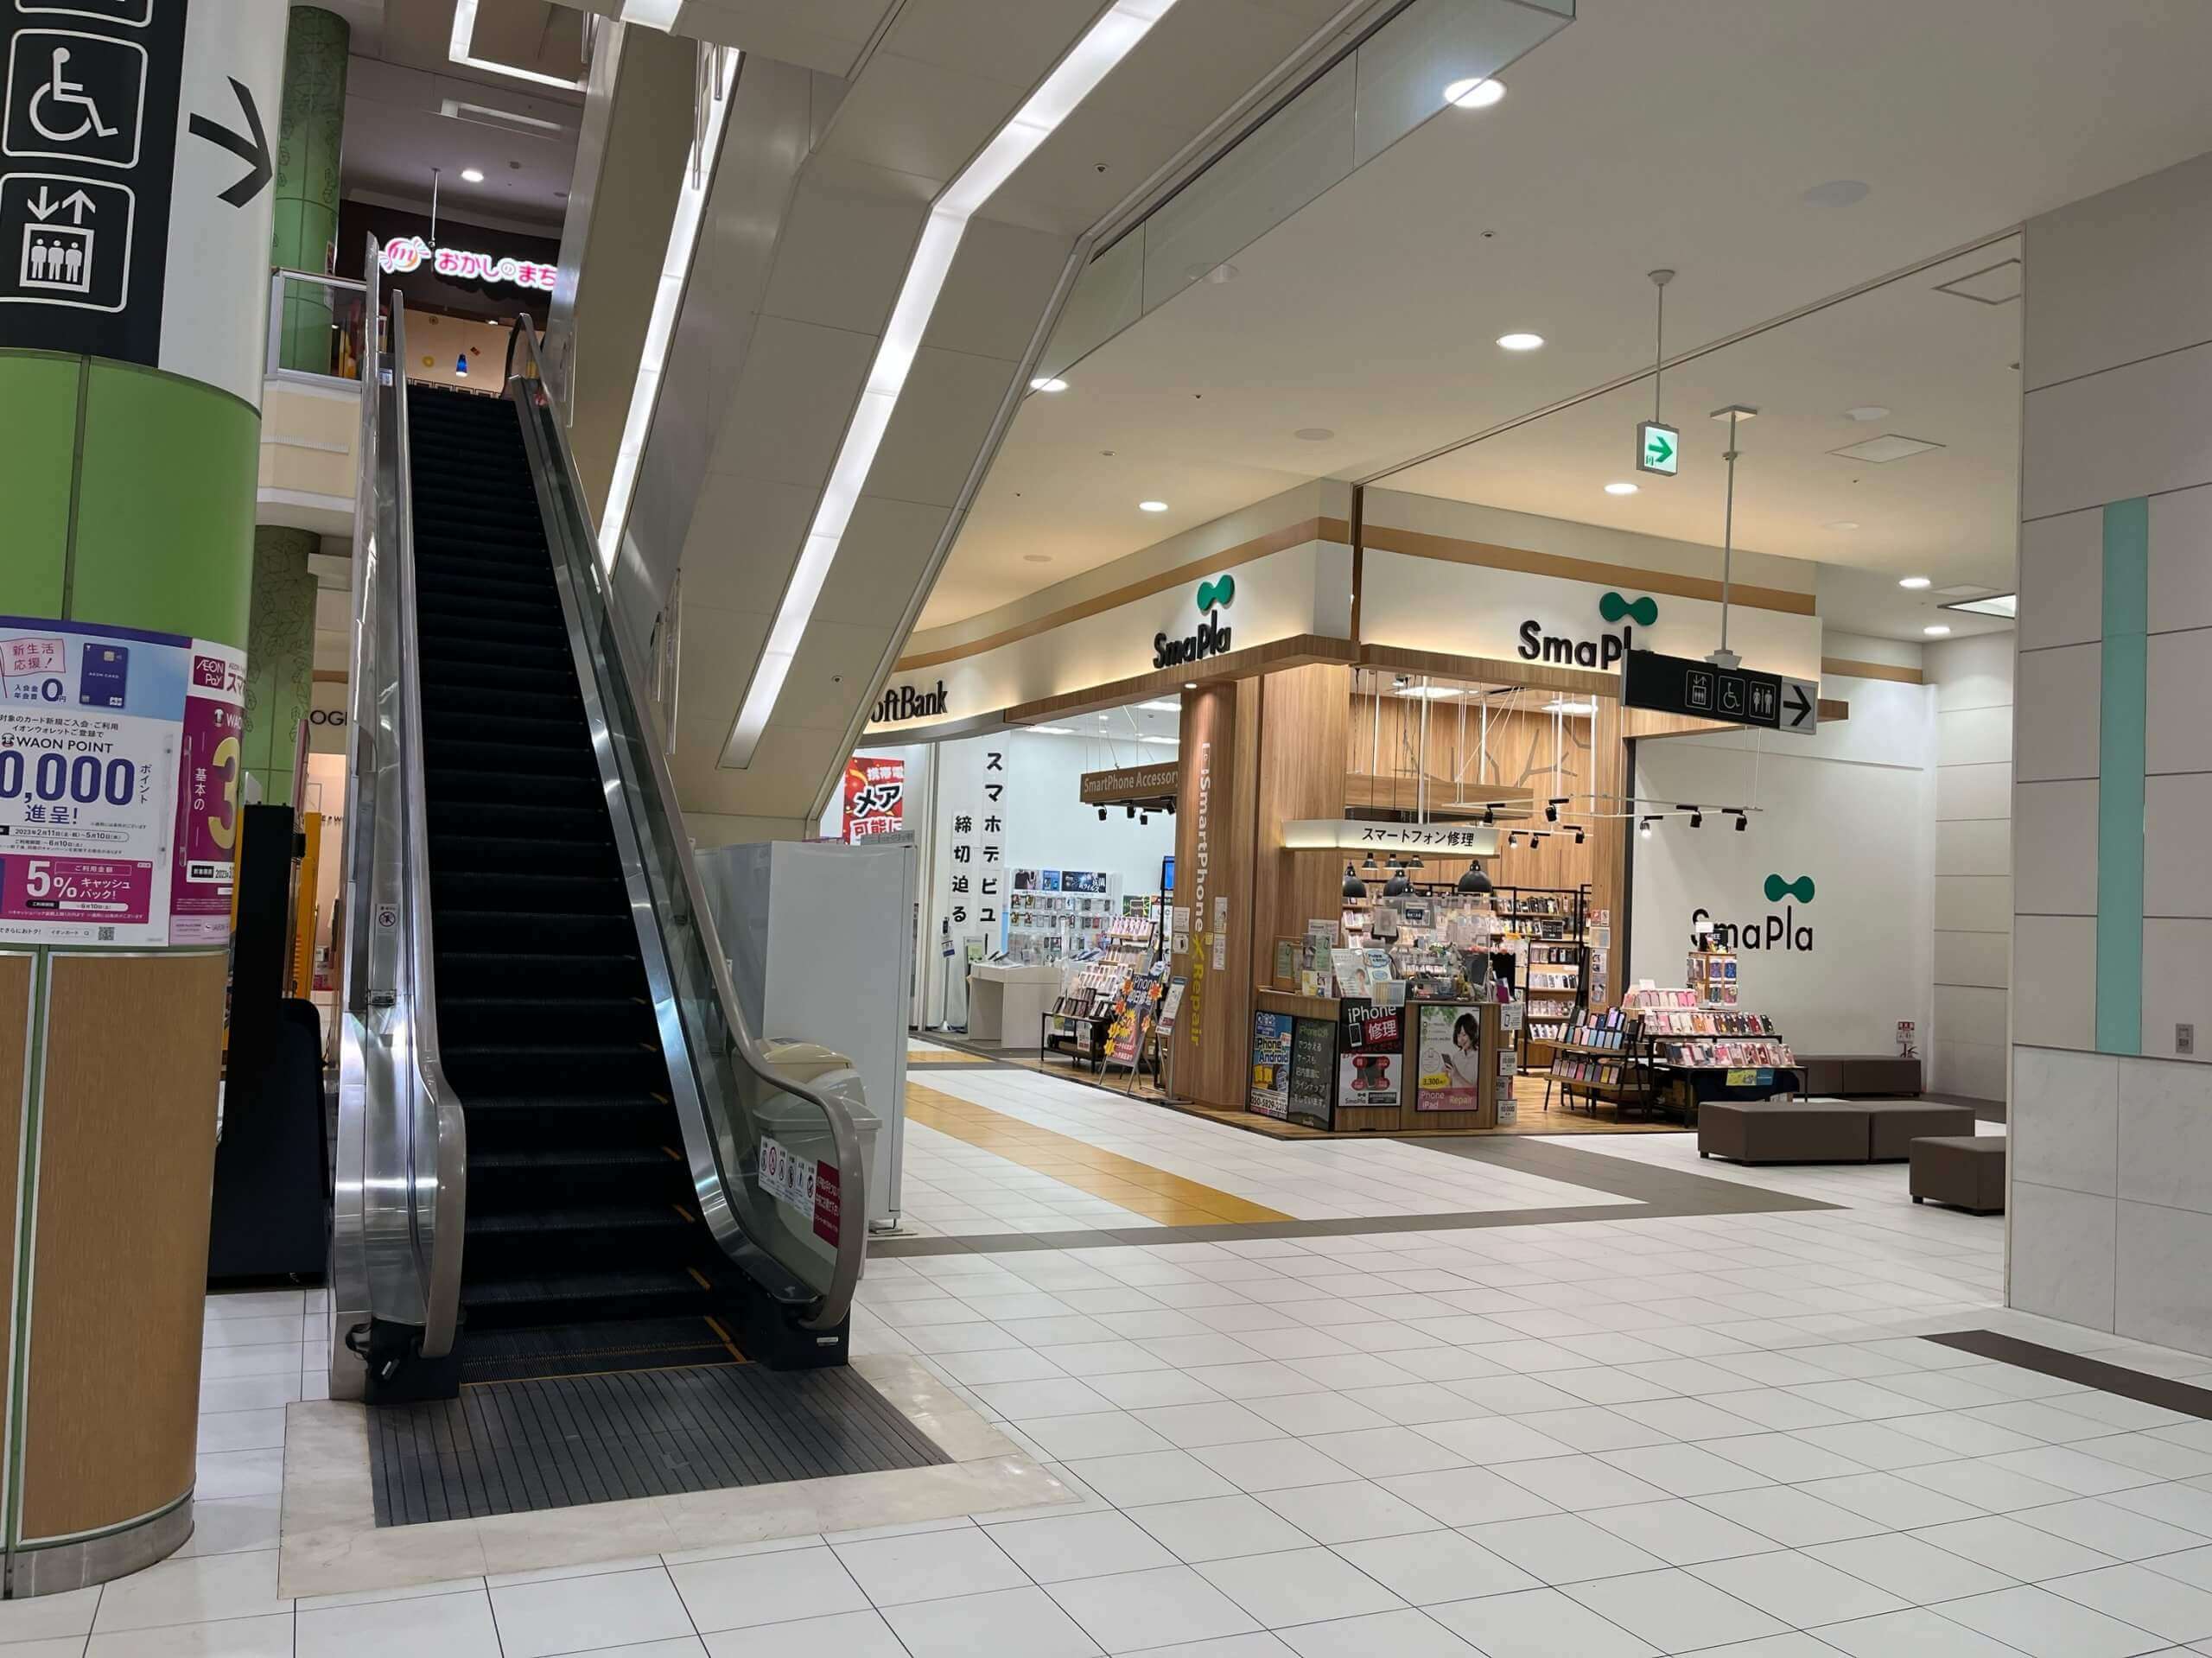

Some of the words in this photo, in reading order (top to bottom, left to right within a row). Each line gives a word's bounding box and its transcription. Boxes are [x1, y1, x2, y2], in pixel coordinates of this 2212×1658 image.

[1153, 609, 1231, 669] SmaPla
[1517, 619, 1655, 670] SmaPl
[13, 643, 54, 656] 新生活
[16, 735, 64, 750] WAON
[67, 740, 114, 753] POINT
[139, 764, 153, 804] ポイント
[194, 768, 207, 811] 基本の
[1084, 773, 1135, 793] SmartPhone
[1363, 828, 1474, 847] スマートフォン修理
[980, 753, 1003, 955] スマホデビュー
[1195, 776, 1211, 932] SmartPhone
[952, 815, 972, 922] 締切迫る
[80, 877, 130, 889] キャッシュ
[1190, 963, 1205, 1045] Repair
[1348, 1005, 1397, 1024] iPhone
[1368, 1020, 1397, 1040] 修理
[1255, 1039, 1282, 1051] iPhone
[1259, 1051, 1289, 1064] Android
